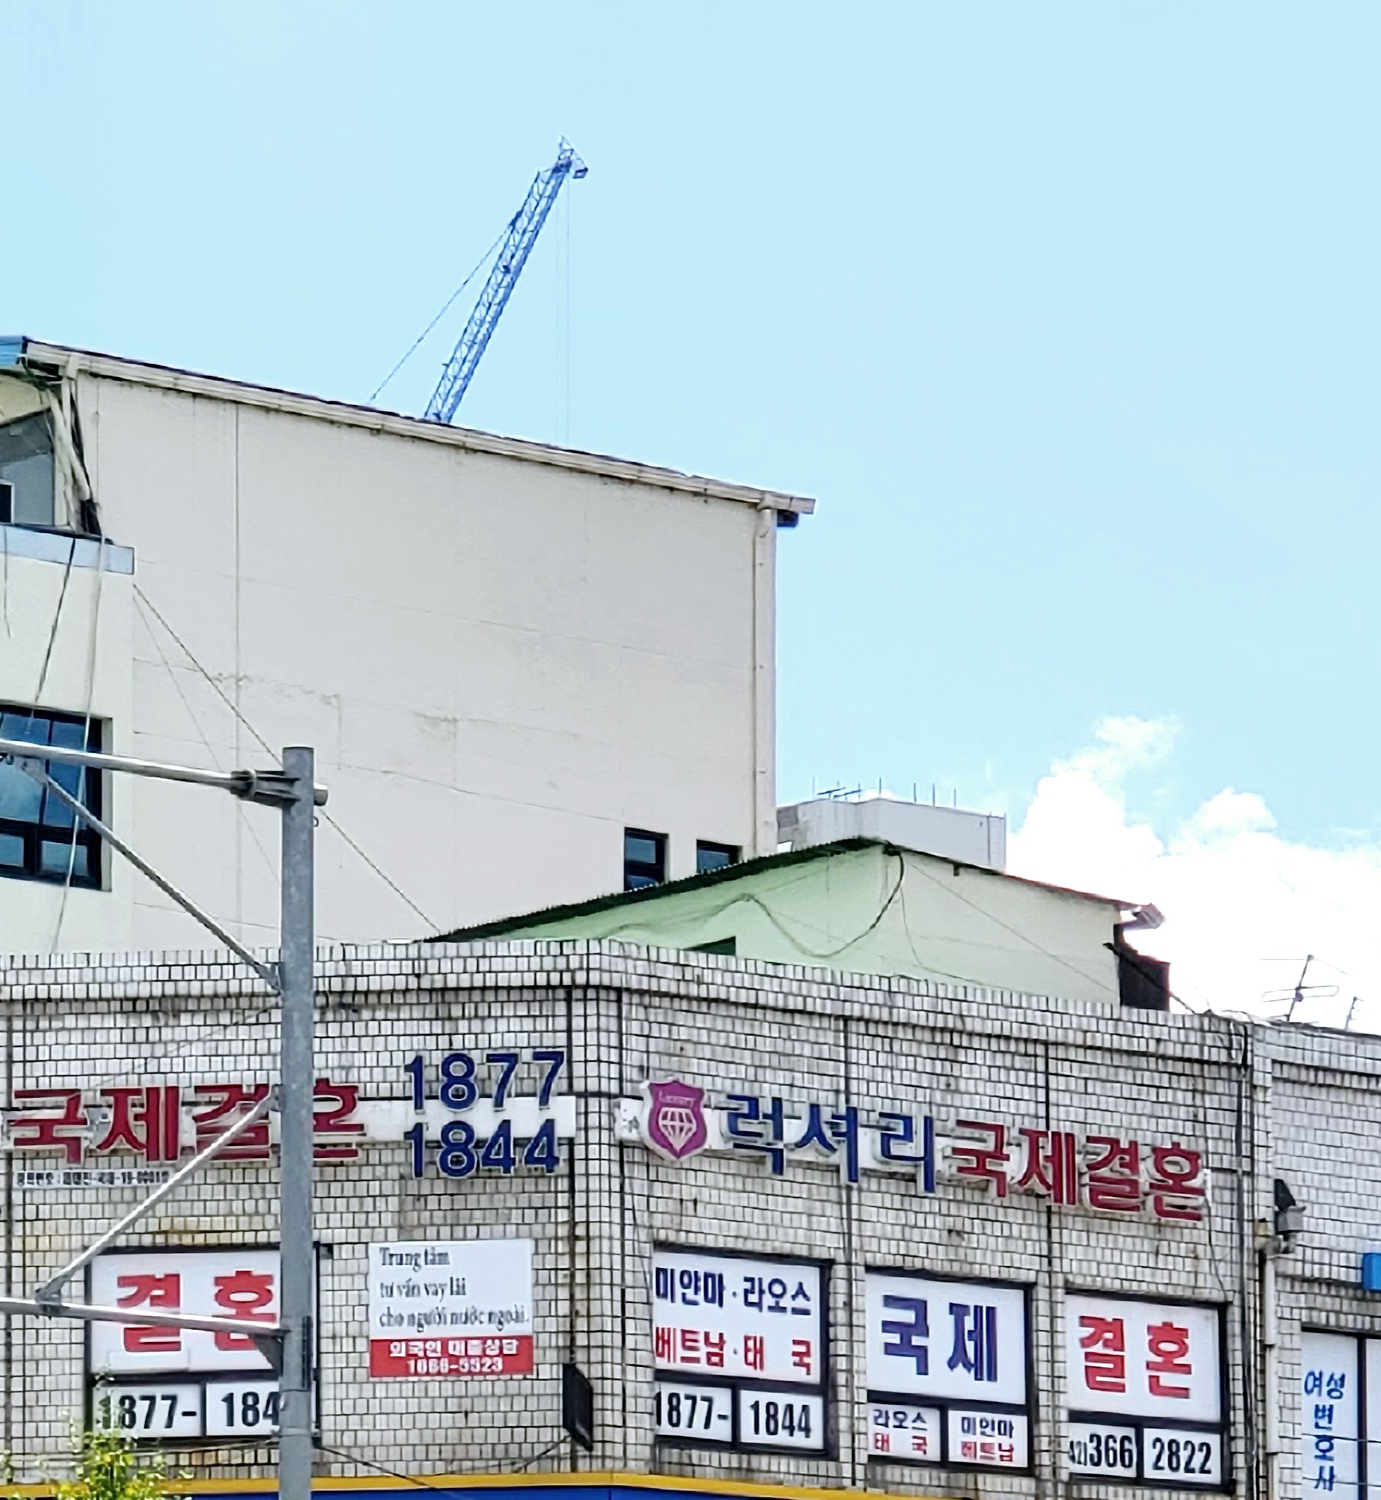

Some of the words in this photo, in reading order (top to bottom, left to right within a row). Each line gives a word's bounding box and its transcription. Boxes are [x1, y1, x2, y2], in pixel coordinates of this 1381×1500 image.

[404, 1051, 565, 1111] 1877
[7, 1078, 365, 1164] 국제결혼
[405, 1119, 561, 1178] 1844
[725, 1094, 935, 1195] 럭셔리
[951, 1120, 1207, 1222] 국제결혼
[379, 1247, 421, 1272] Trung
[116, 1270, 277, 1353] 결혼
[379, 1307, 405, 1328] cho
[882, 1294, 998, 1383] 국제
[1078, 1314, 1192, 1399] 결혼
[221, 1391, 281, 1428] 184
[1304, 1370, 1346, 1400] 여성
[750, 1400, 812, 1438] 1844
[873, 1408, 928, 1431] 라오스
[1152, 1436, 1212, 1475] 2822
